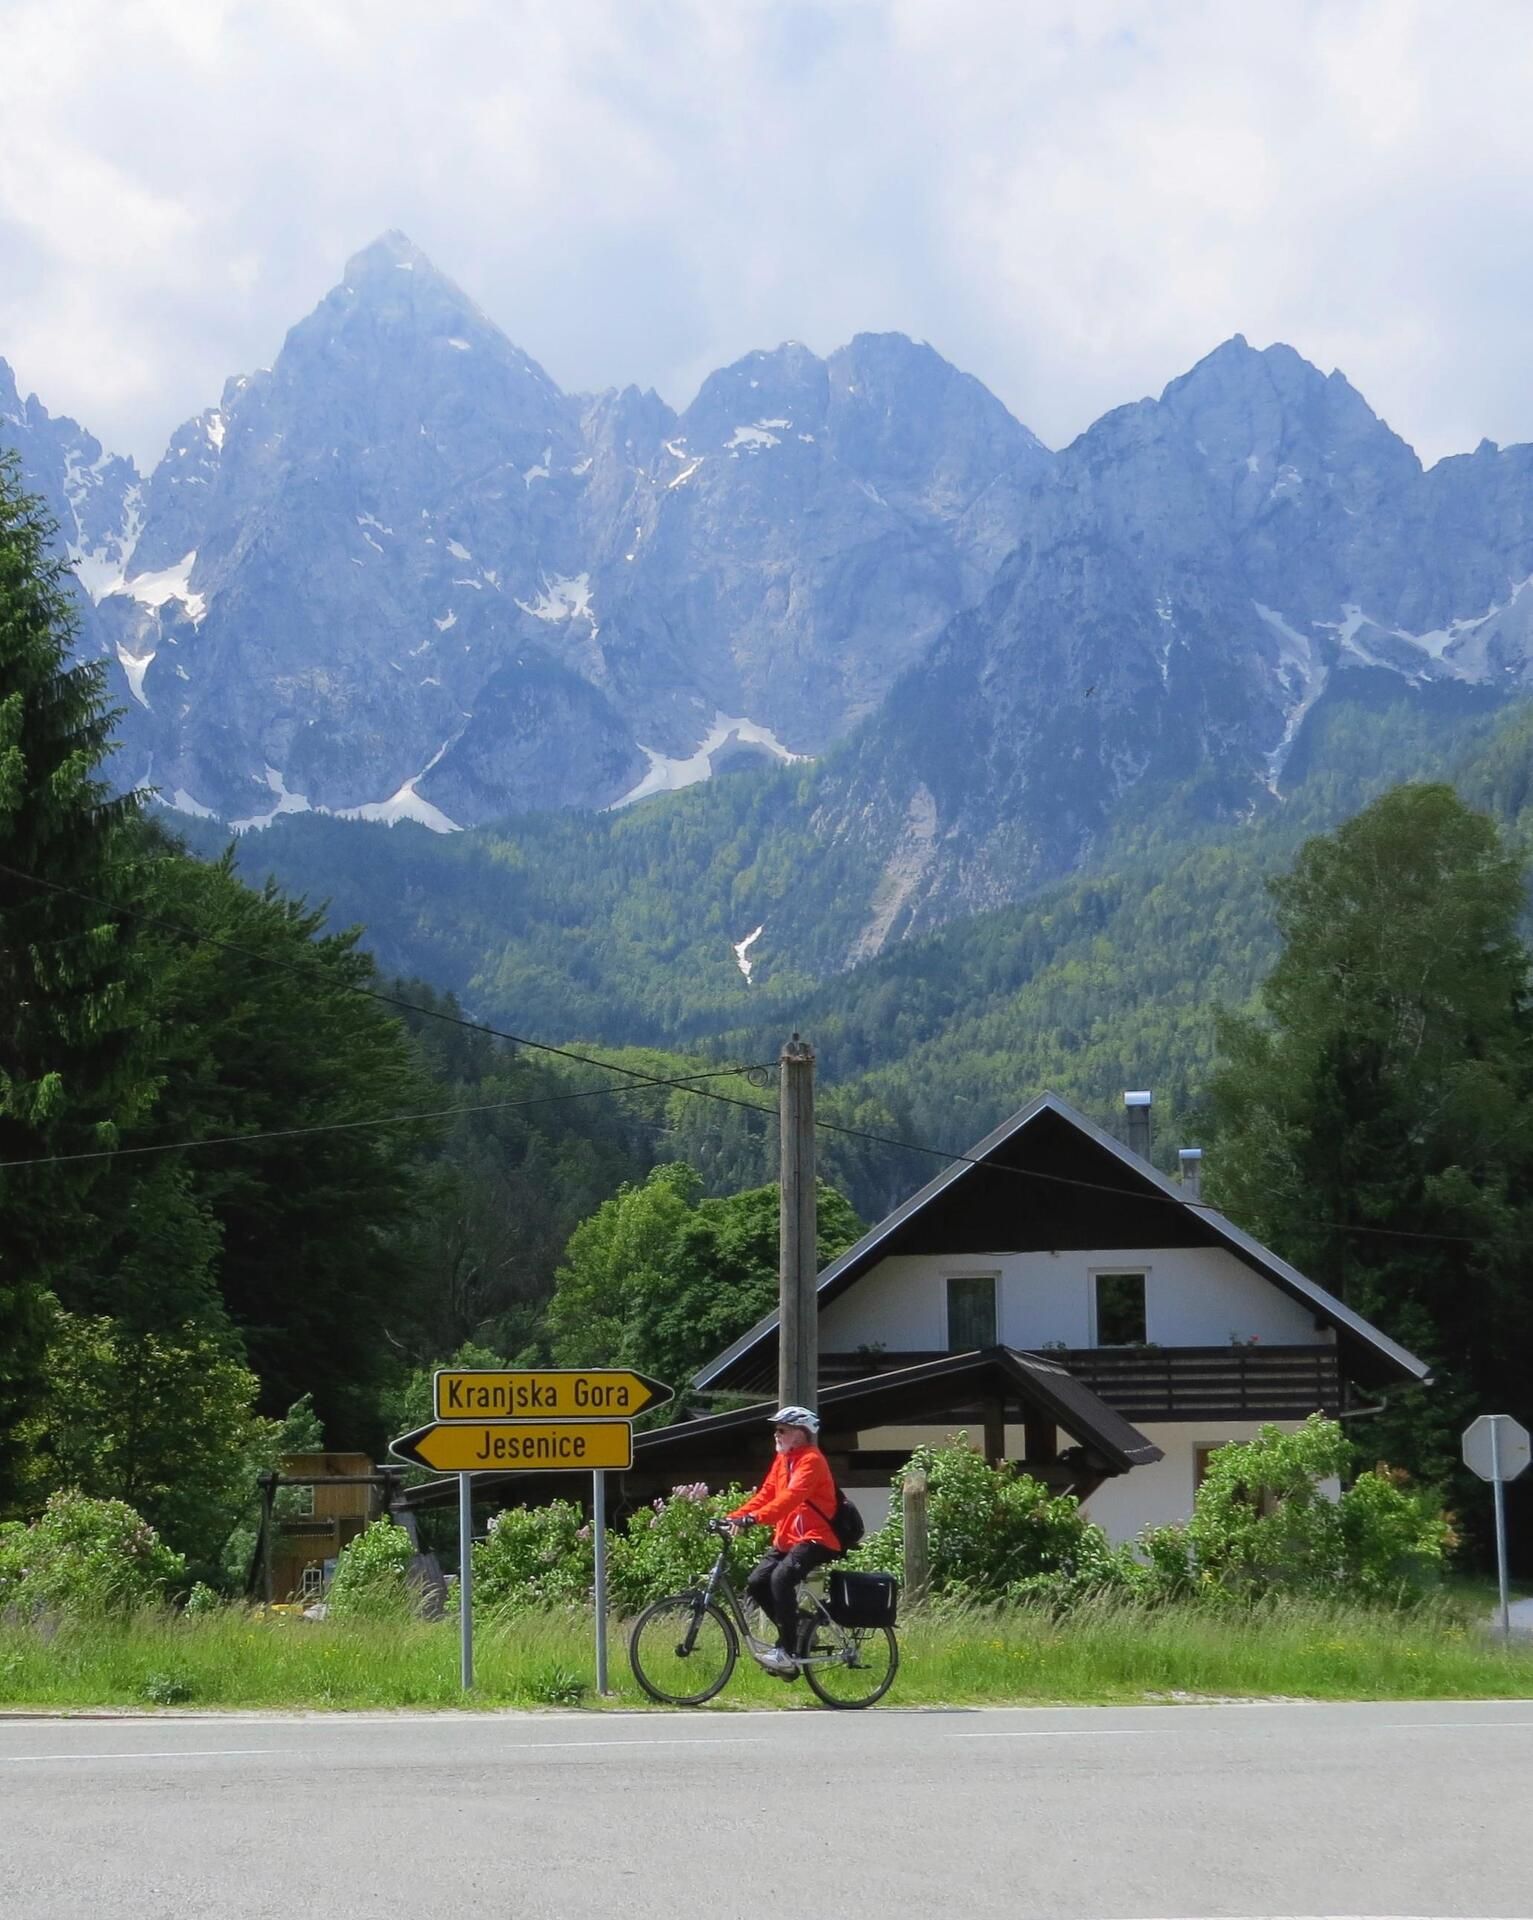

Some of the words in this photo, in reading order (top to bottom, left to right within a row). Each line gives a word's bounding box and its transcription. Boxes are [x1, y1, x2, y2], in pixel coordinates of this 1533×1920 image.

[448, 1379, 557, 1415] Kranjska
[574, 1378, 629, 1407] Gora
[476, 1430, 586, 1460] Jesenice
